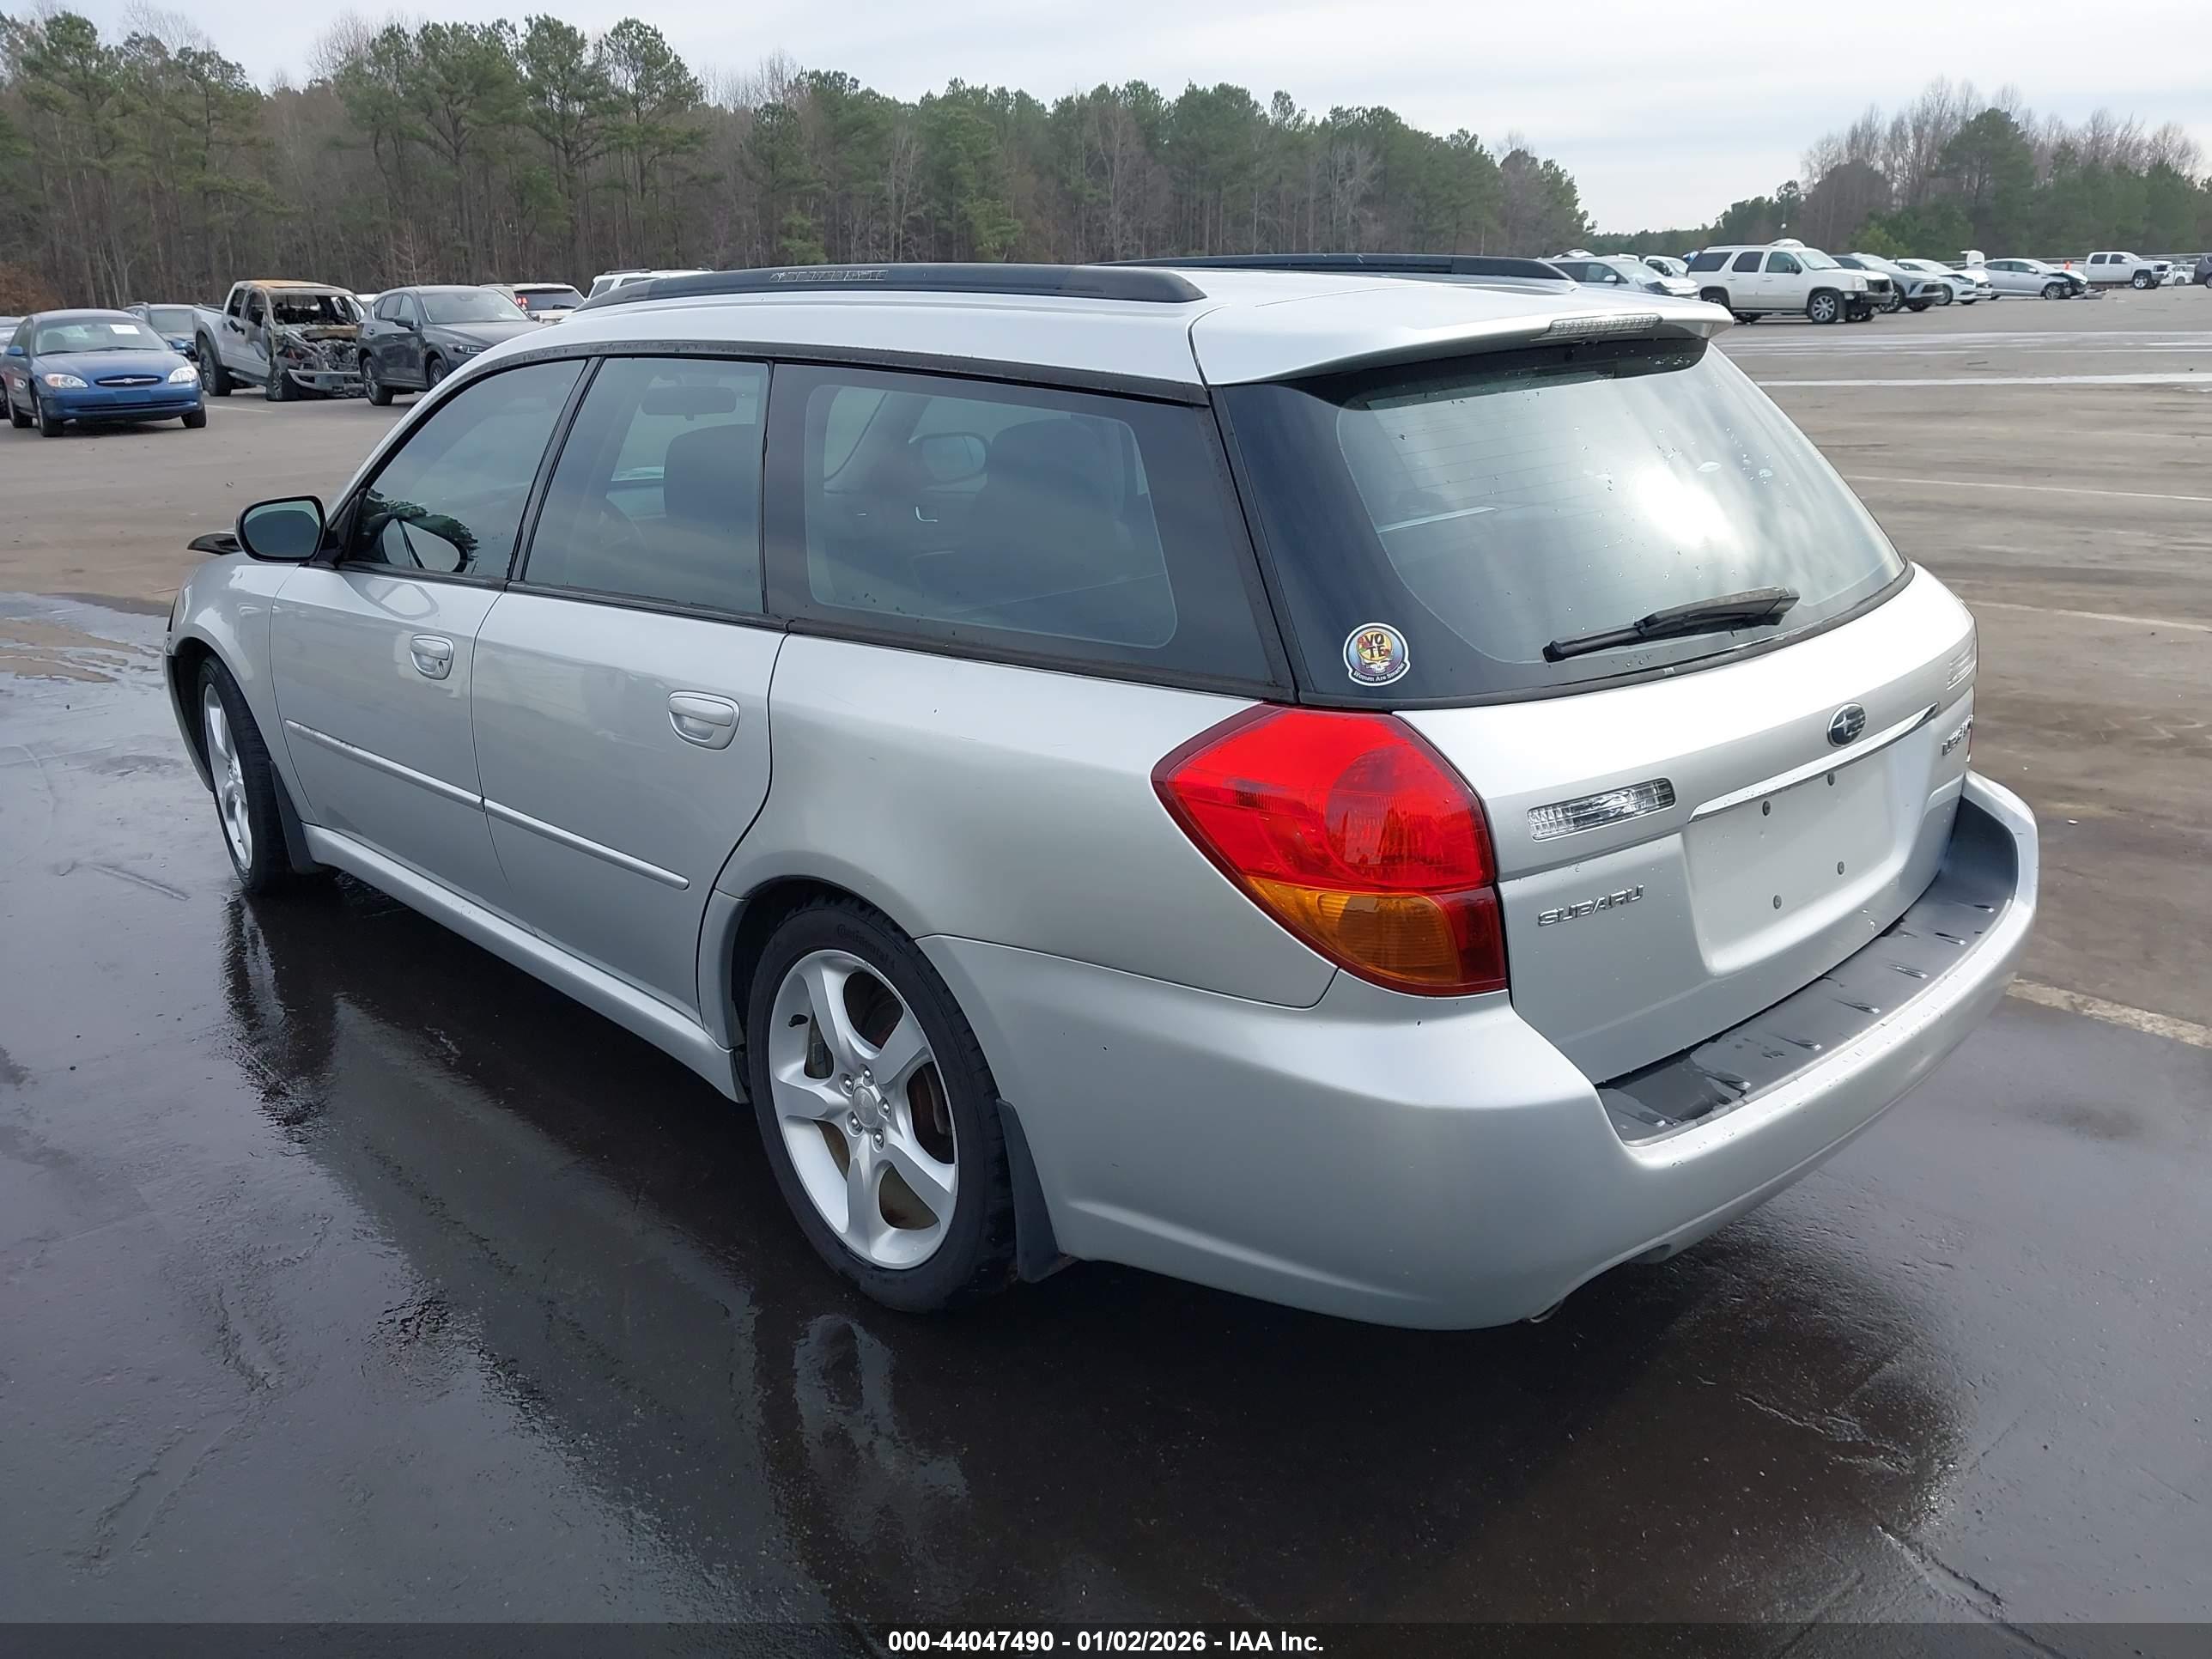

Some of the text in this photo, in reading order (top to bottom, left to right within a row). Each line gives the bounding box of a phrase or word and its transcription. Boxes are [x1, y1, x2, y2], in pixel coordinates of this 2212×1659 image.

[1364, 633, 1385, 647] VO
[1353, 670, 1375, 682] Women
[1538, 883, 1644, 927] SUBARU
